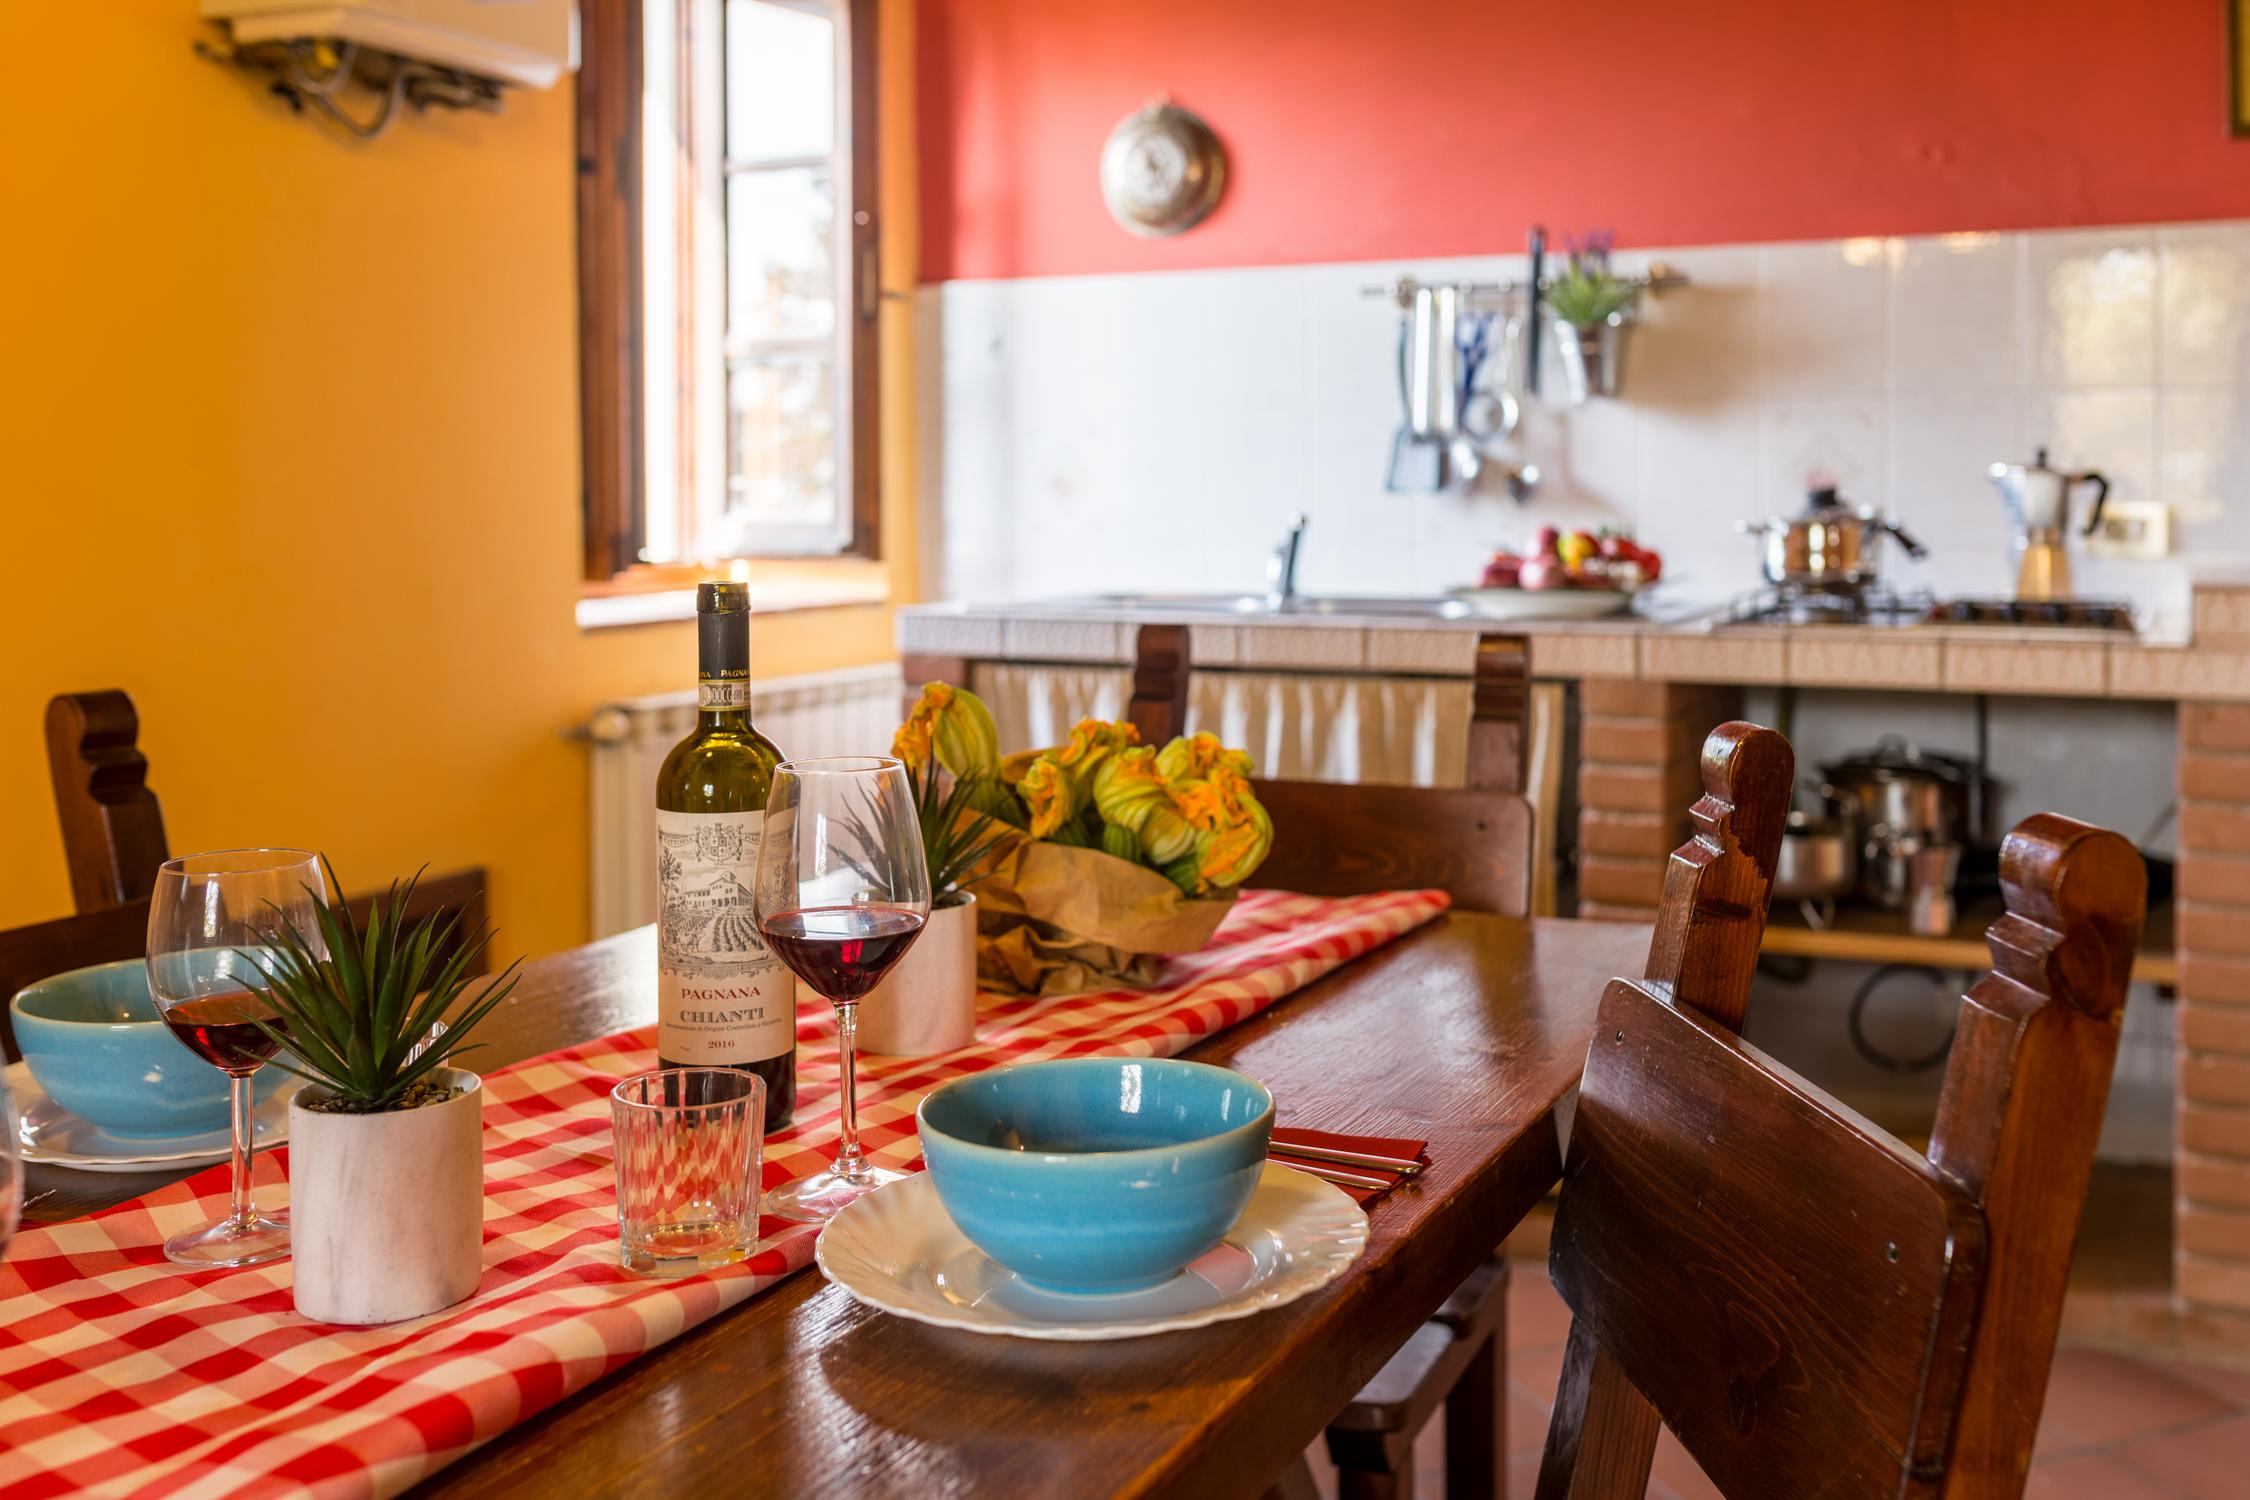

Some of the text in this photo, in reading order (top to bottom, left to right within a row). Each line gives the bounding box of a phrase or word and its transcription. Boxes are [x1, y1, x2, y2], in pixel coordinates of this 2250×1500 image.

[681, 986, 761, 1000] PAGNANA
[680, 1007, 765, 1023] CHIANTI
[708, 1040, 735, 1049] 2016
